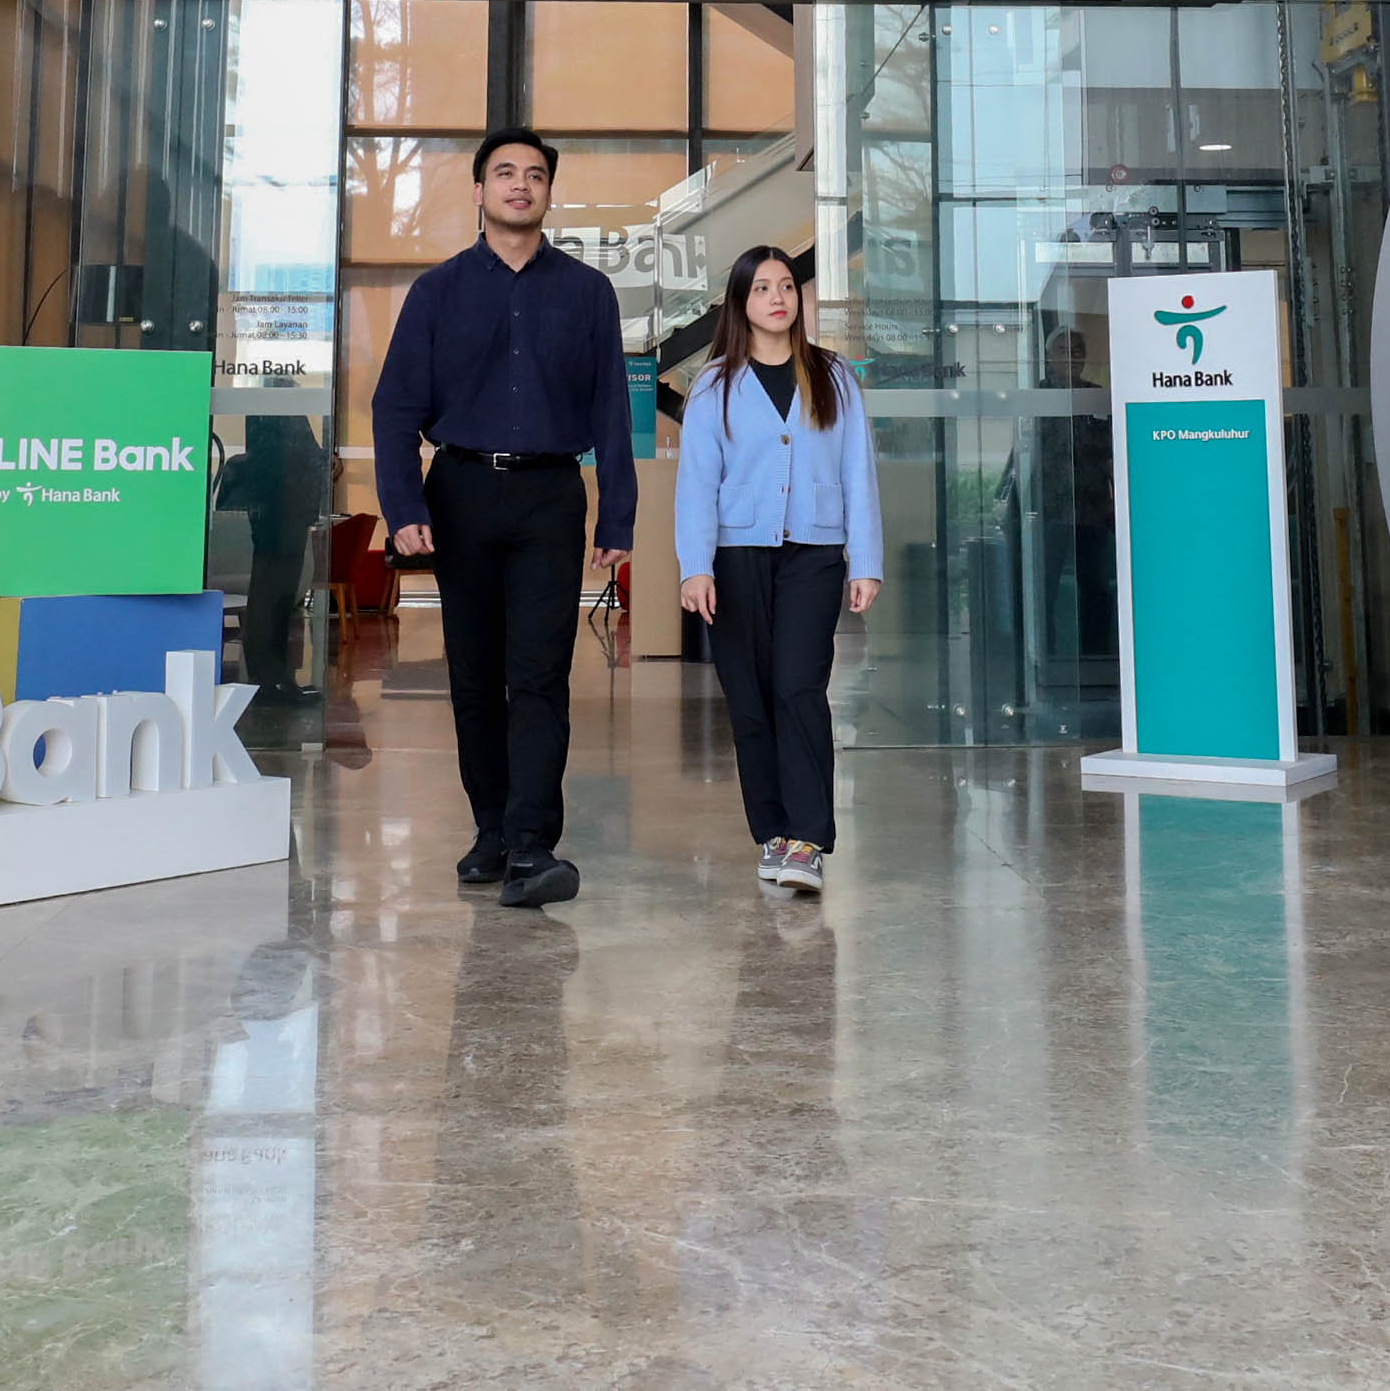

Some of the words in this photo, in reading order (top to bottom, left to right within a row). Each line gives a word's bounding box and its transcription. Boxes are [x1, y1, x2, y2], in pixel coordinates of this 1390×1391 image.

[214, 360, 258, 375] Hana
[263, 360, 306, 375] Bank
[1152, 372, 1191, 388] Hana
[1194, 370, 1233, 386] Bank
[1152, 430, 1176, 441] KPO
[1178, 429, 1249, 442] Mangkuluhur
[93, 437, 195, 471] Bank
[42, 488, 81, 503] Hana
[83, 487, 120, 503] Bank
